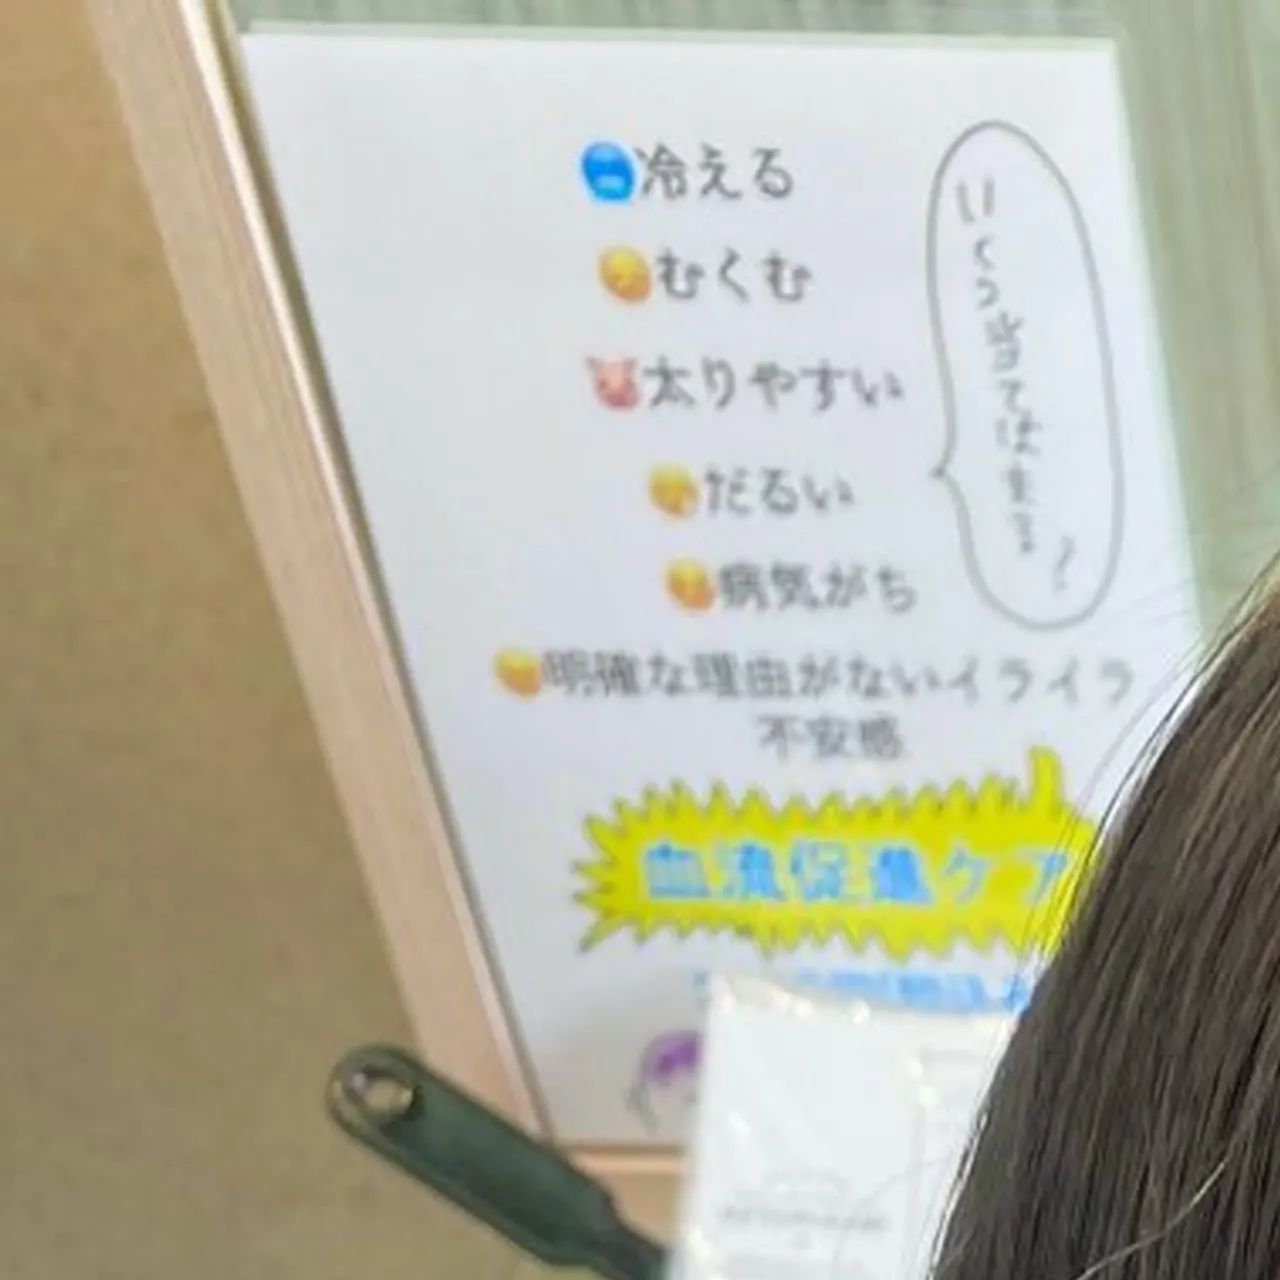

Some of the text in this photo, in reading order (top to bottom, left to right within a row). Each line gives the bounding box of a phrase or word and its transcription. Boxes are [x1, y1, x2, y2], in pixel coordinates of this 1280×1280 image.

[637, 143, 794, 199] 冷える
[657, 247, 812, 304] むくむ
[643, 355, 905, 409] 太りやすい
[705, 467, 854, 515] だるい
[718, 560, 917, 612] 病気がち
[543, 651, 1133, 698] 明確な理由がないイライラ
[758, 714, 904, 758] 不安感
